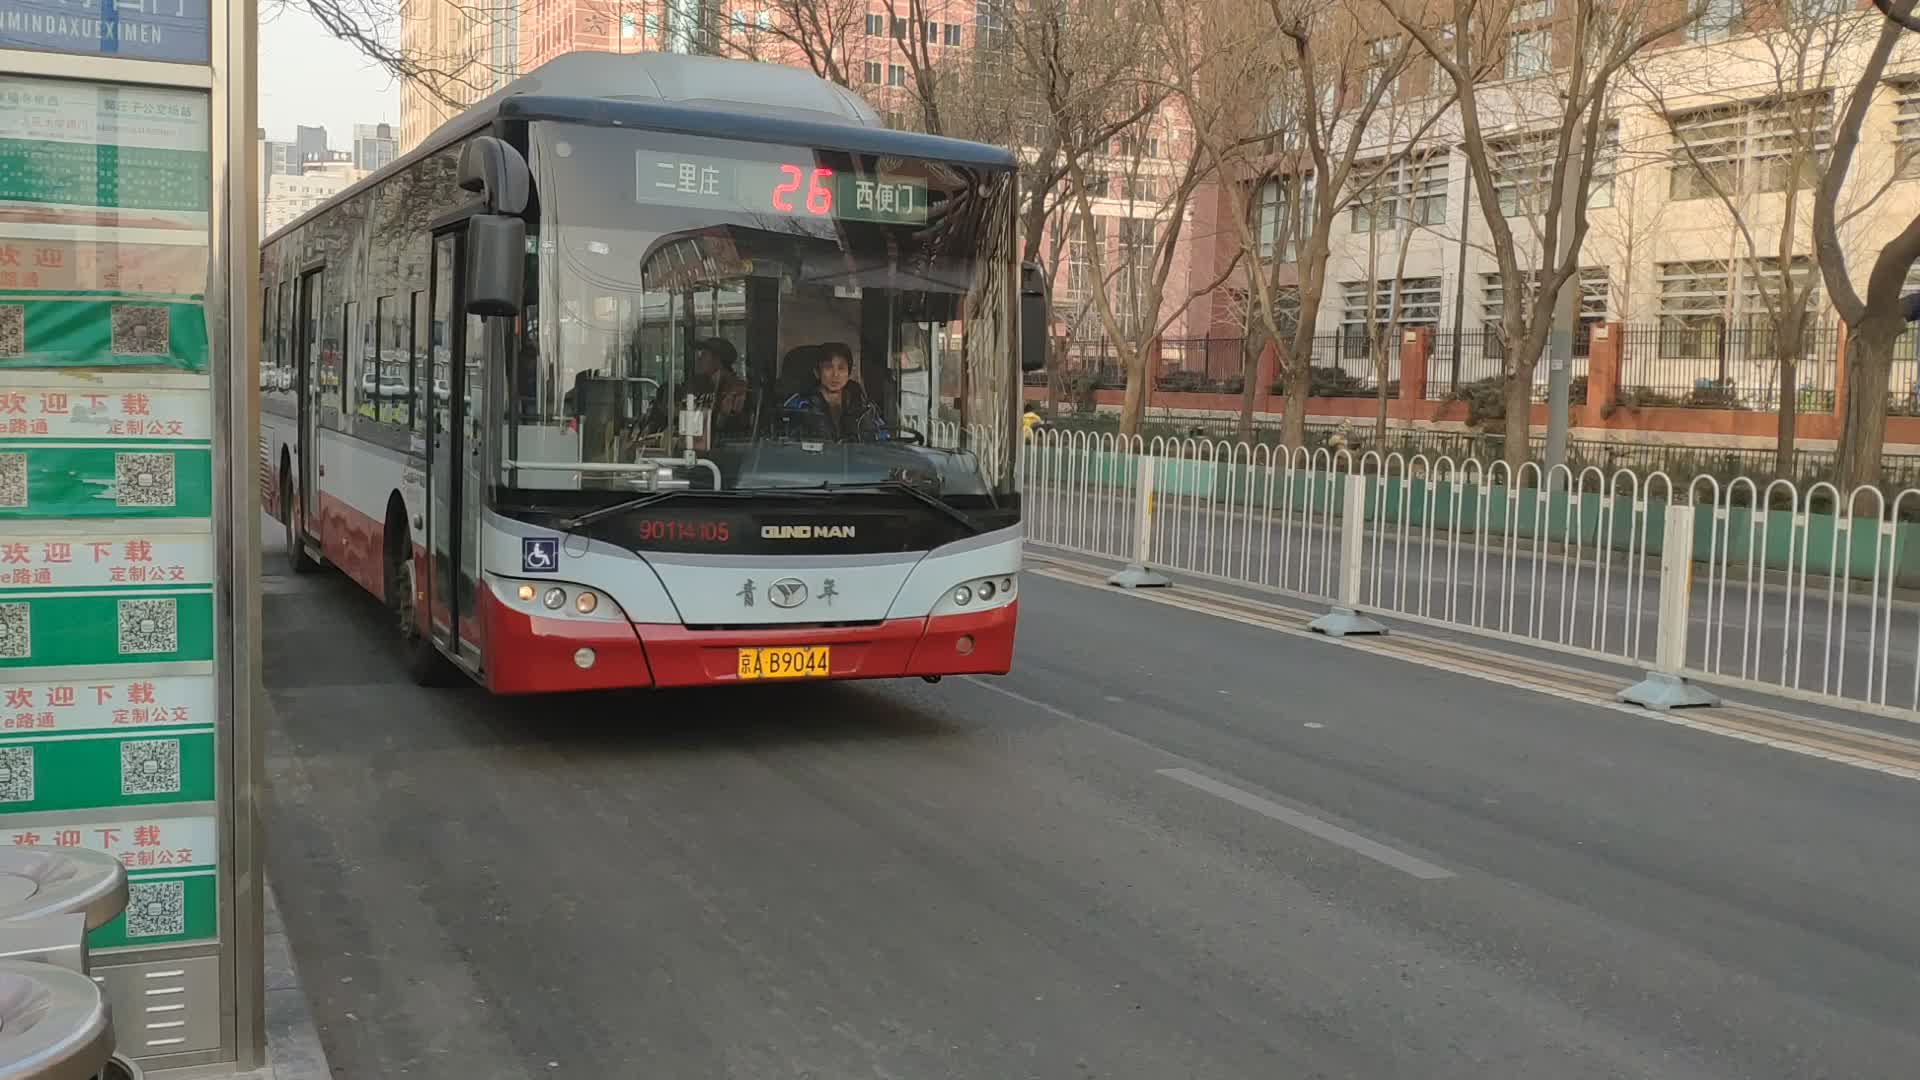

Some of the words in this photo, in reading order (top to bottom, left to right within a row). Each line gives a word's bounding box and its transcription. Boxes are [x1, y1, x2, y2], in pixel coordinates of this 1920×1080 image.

[655, 161, 720, 196] 二里庄
[772, 164, 833, 215] 26
[856, 180, 913, 214] 西便门
[108, 419, 184, 436] 定制公交
[1, 540, 153, 564] 欢迎下载
[109, 565, 185, 582] 定制公交
[5, 681, 156, 709] 欢迎下载
[4, 711, 56, 729] e路通
[111, 706, 189, 724] 定制公交
[119, 849, 193, 867] 定制公交
